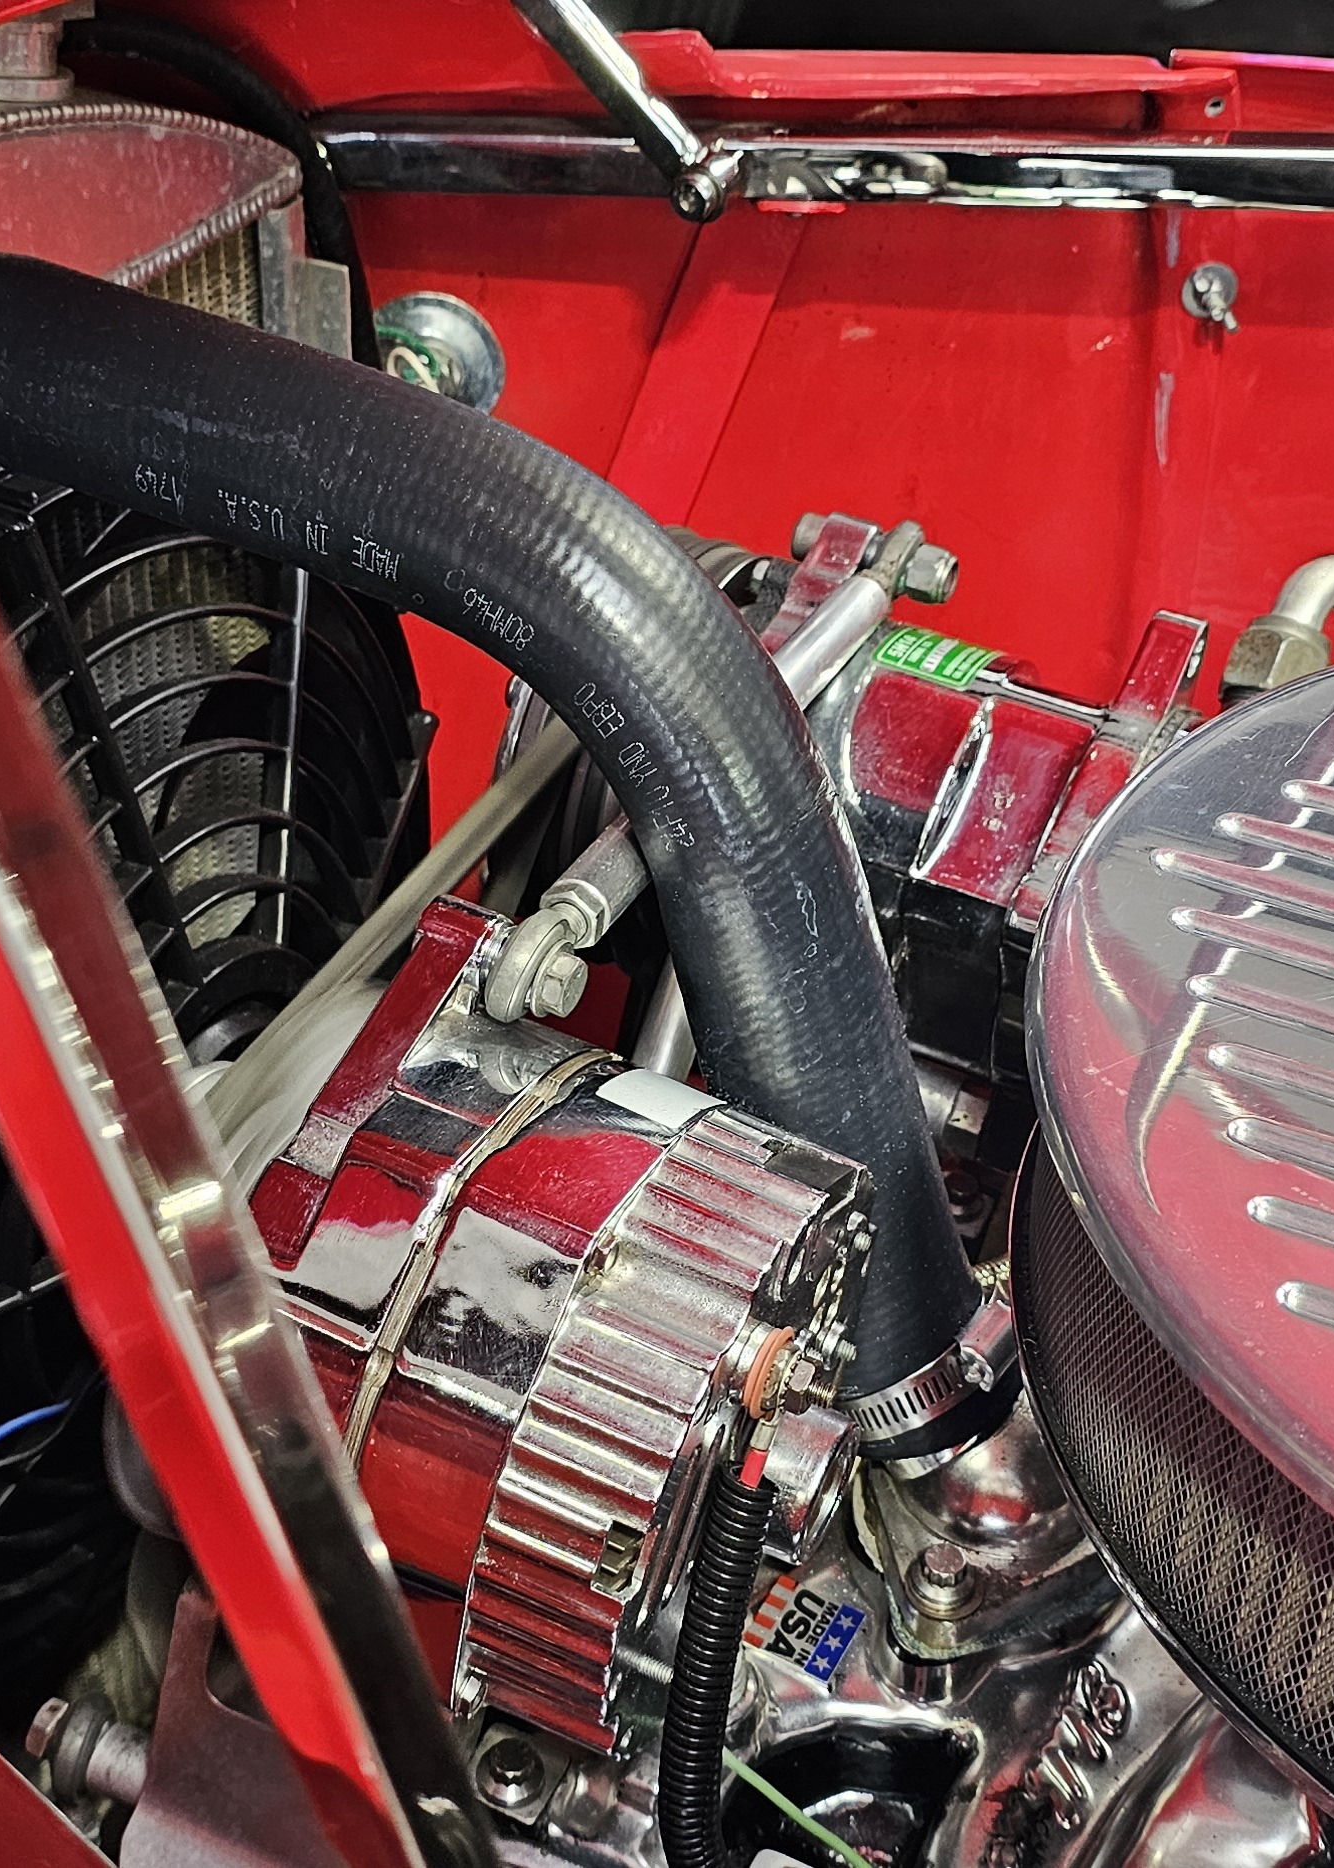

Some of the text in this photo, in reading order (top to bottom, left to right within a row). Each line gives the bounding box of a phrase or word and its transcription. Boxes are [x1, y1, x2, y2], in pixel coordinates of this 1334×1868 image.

[218, 489, 285, 540] U.S.A.
[306, 520, 328, 555] IN
[351, 535, 401, 581] MADE
[765, 1589, 825, 1658] USA
[793, 1602, 839, 1667] MADE IN
